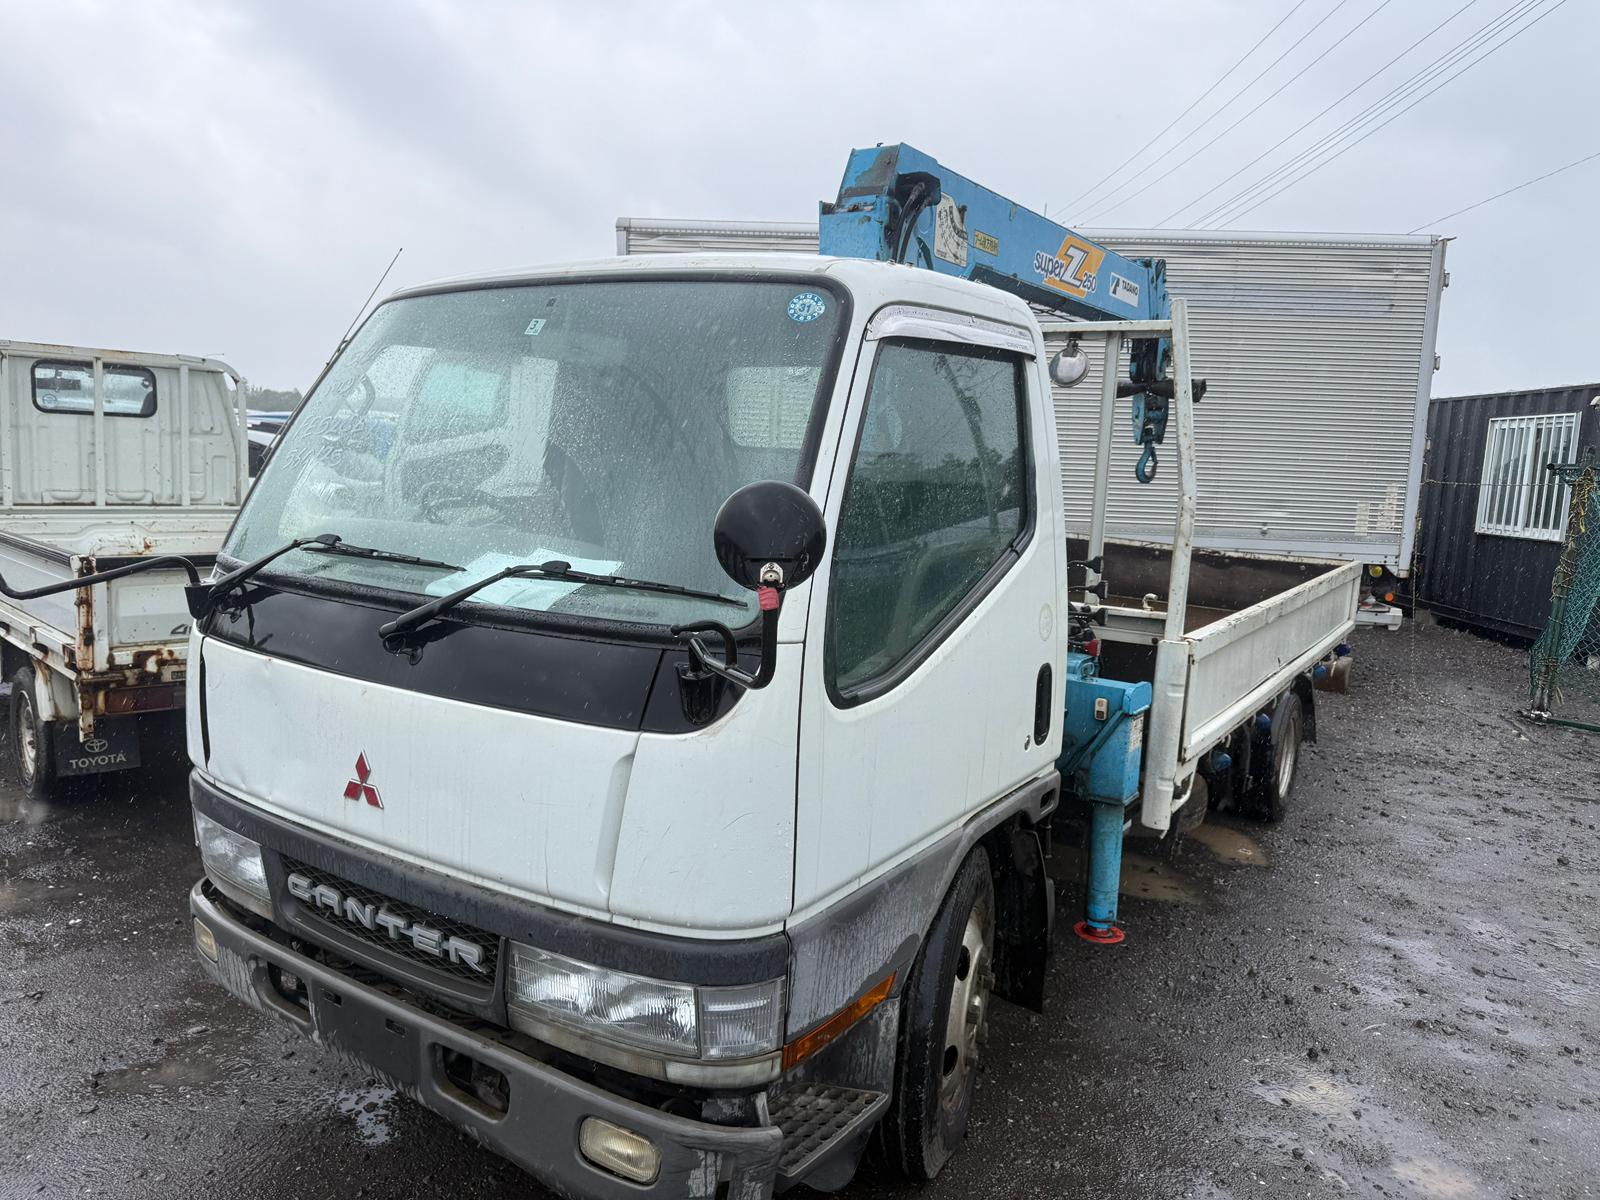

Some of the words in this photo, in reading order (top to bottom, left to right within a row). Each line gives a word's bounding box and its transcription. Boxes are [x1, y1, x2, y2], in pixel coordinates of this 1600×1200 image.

[1033, 251, 1064, 278] super
[1082, 271, 1097, 292] 250
[1121, 279, 1138, 297] TADANO
[69, 753, 127, 769] TOYOTA
[287, 872, 490, 974] CANTER
